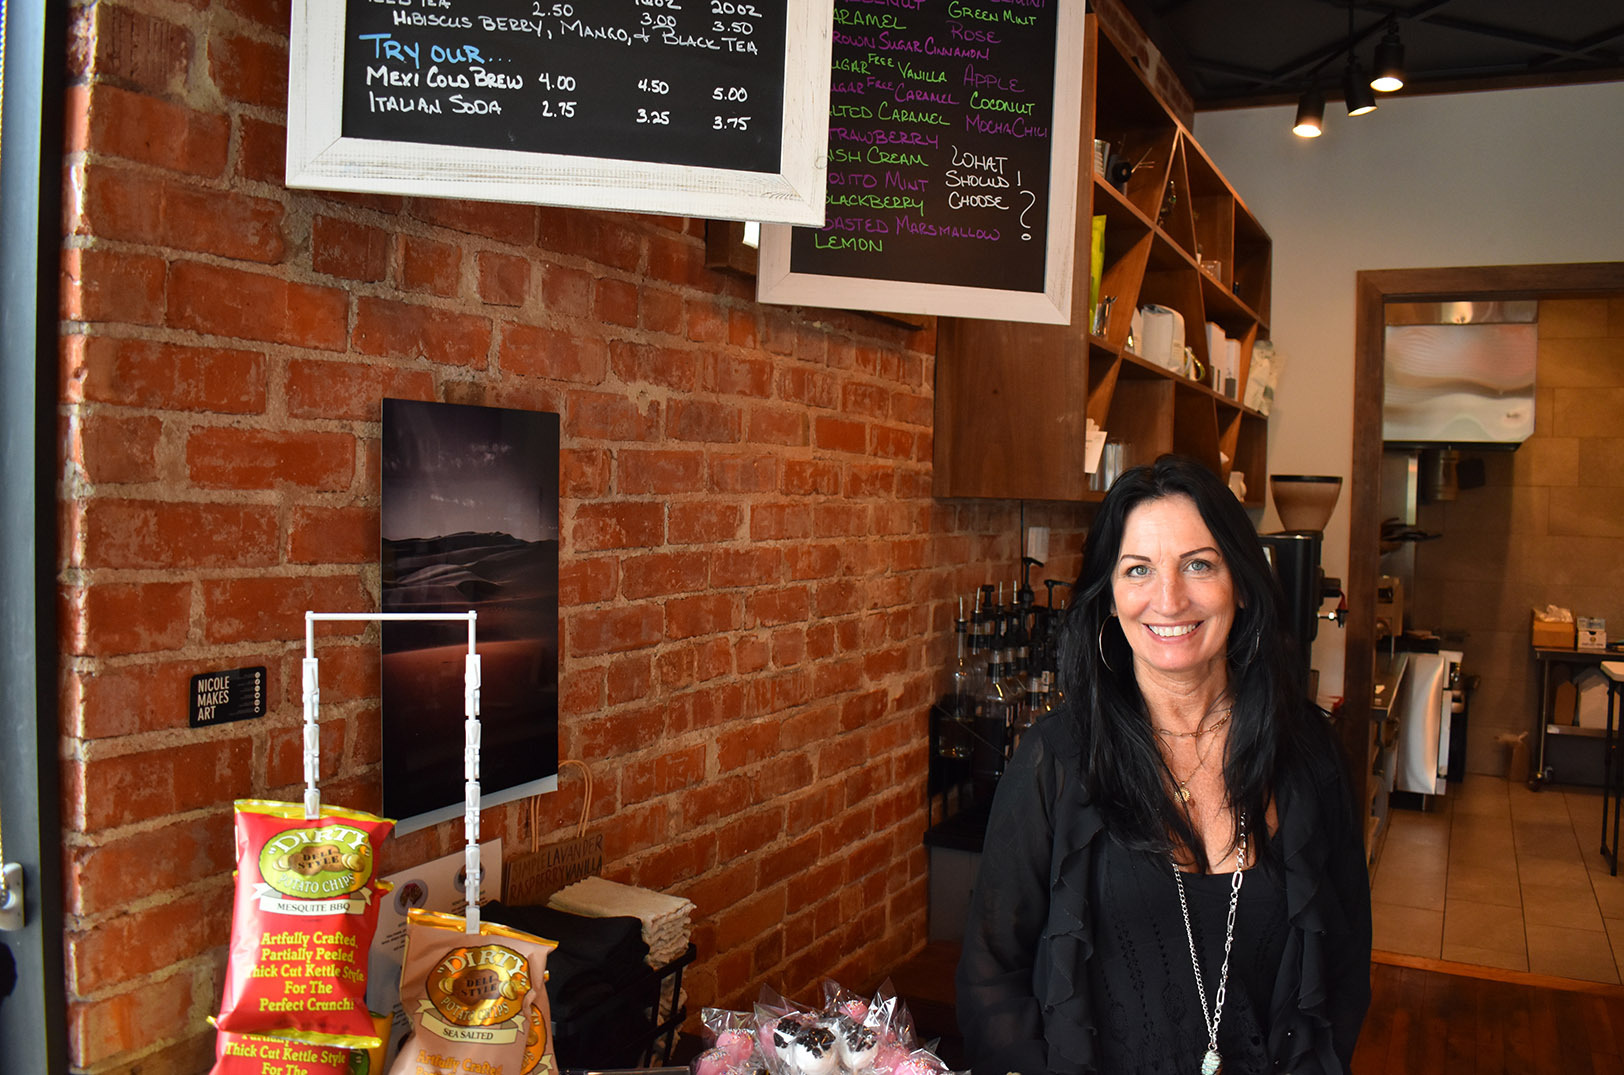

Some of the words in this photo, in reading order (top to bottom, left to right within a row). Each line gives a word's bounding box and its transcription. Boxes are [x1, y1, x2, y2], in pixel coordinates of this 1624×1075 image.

[532, 2, 574, 17] 2.50
[833, 8, 907, 29] ARAMEL
[948, 1, 999, 22] GREEN
[1003, 10, 1037, 25] MINT
[393, 10, 472, 28] HIBISCUS
[652, 25, 720, 50] BLACK
[720, 37, 758, 54] TEA
[640, 12, 676, 26] 3.00
[712, 21, 754, 34] 3.50
[946, 20, 1001, 44] ROSE
[359, 33, 420, 70] TRY
[832, 30, 876, 48] ROWN
[879, 31, 922, 52] SUGAR
[924, 36, 990, 60] CINNAMON
[832, 58, 870, 74] UGAR
[868, 53, 894, 68] FREE
[898, 62, 947, 82] VANILLA
[964, 64, 1024, 92] APPLE
[366, 65, 420, 87] MEXI
[426, 65, 470, 88] COLD
[470, 66, 523, 90] BREW
[538, 72, 576, 90] 4.00
[638, 79, 670, 94] 4.50
[712, 87, 748, 102] 5.00
[830, 81, 864, 94] UGAR
[866, 76, 894, 90] FREE
[895, 82, 960, 104] CARAMEL
[369, 90, 442, 114] ITALIAN
[449, 94, 502, 115] SODA
[542, 101, 577, 118] 2.75
[636, 108, 670, 124] 3.25
[712, 116, 751, 130] 3.75
[830, 104, 873, 118] LTED
[878, 101, 950, 126] CARAMEL
[970, 91, 1036, 116] COCONUT
[828, 128, 938, 150] TRAWBERRY
[828, 149, 862, 162] ISH
[866, 146, 929, 166] CREAM
[952, 145, 1008, 175] WHAT
[828, 172, 878, 188] OJITO
[885, 170, 928, 192] MINT
[948, 191, 1010, 210] CHOOSE
[820, 216, 888, 234] OASTED
[896, 215, 1000, 240] MARSMALLOW
[814, 233, 882, 252] LEMON
[198, 676, 230, 692] NICOLE
[198, 690, 230, 708] MAKES
[197, 706, 216, 721] ART
[566, 854, 603, 881] VANILLA
[278, 874, 319, 893] POTATO
[322, 872, 356, 893] CHIPS
[277, 902, 327, 912] MESQUITE
[330, 902, 350, 912] BBQ
[260, 932, 310, 947] Artfully
[261, 948, 312, 963] Partially
[280, 964, 302, 978] Cut
[305, 964, 340, 978] Kettle
[466, 976, 493, 988] DELI
[284, 981, 306, 994] For
[309, 980, 332, 994] The
[460, 984, 496, 996] STYLE
[259, 998, 304, 1012] Perfect
[307, 998, 354, 1012] Crunch!
[441, 996, 478, 1021] POTATO
[478, 1001, 510, 1021] CHIPS
[443, 1027, 458, 1038] SEA
[460, 1030, 494, 1040] SALTED
[226, 1042, 256, 1058] Thick
[260, 1046, 280, 1060] Cut
[282, 1047, 318, 1064] Kettle
[416, 1050, 460, 1073] Artfully
[262, 1062, 283, 1075] For
[286, 1064, 308, 1075] The
